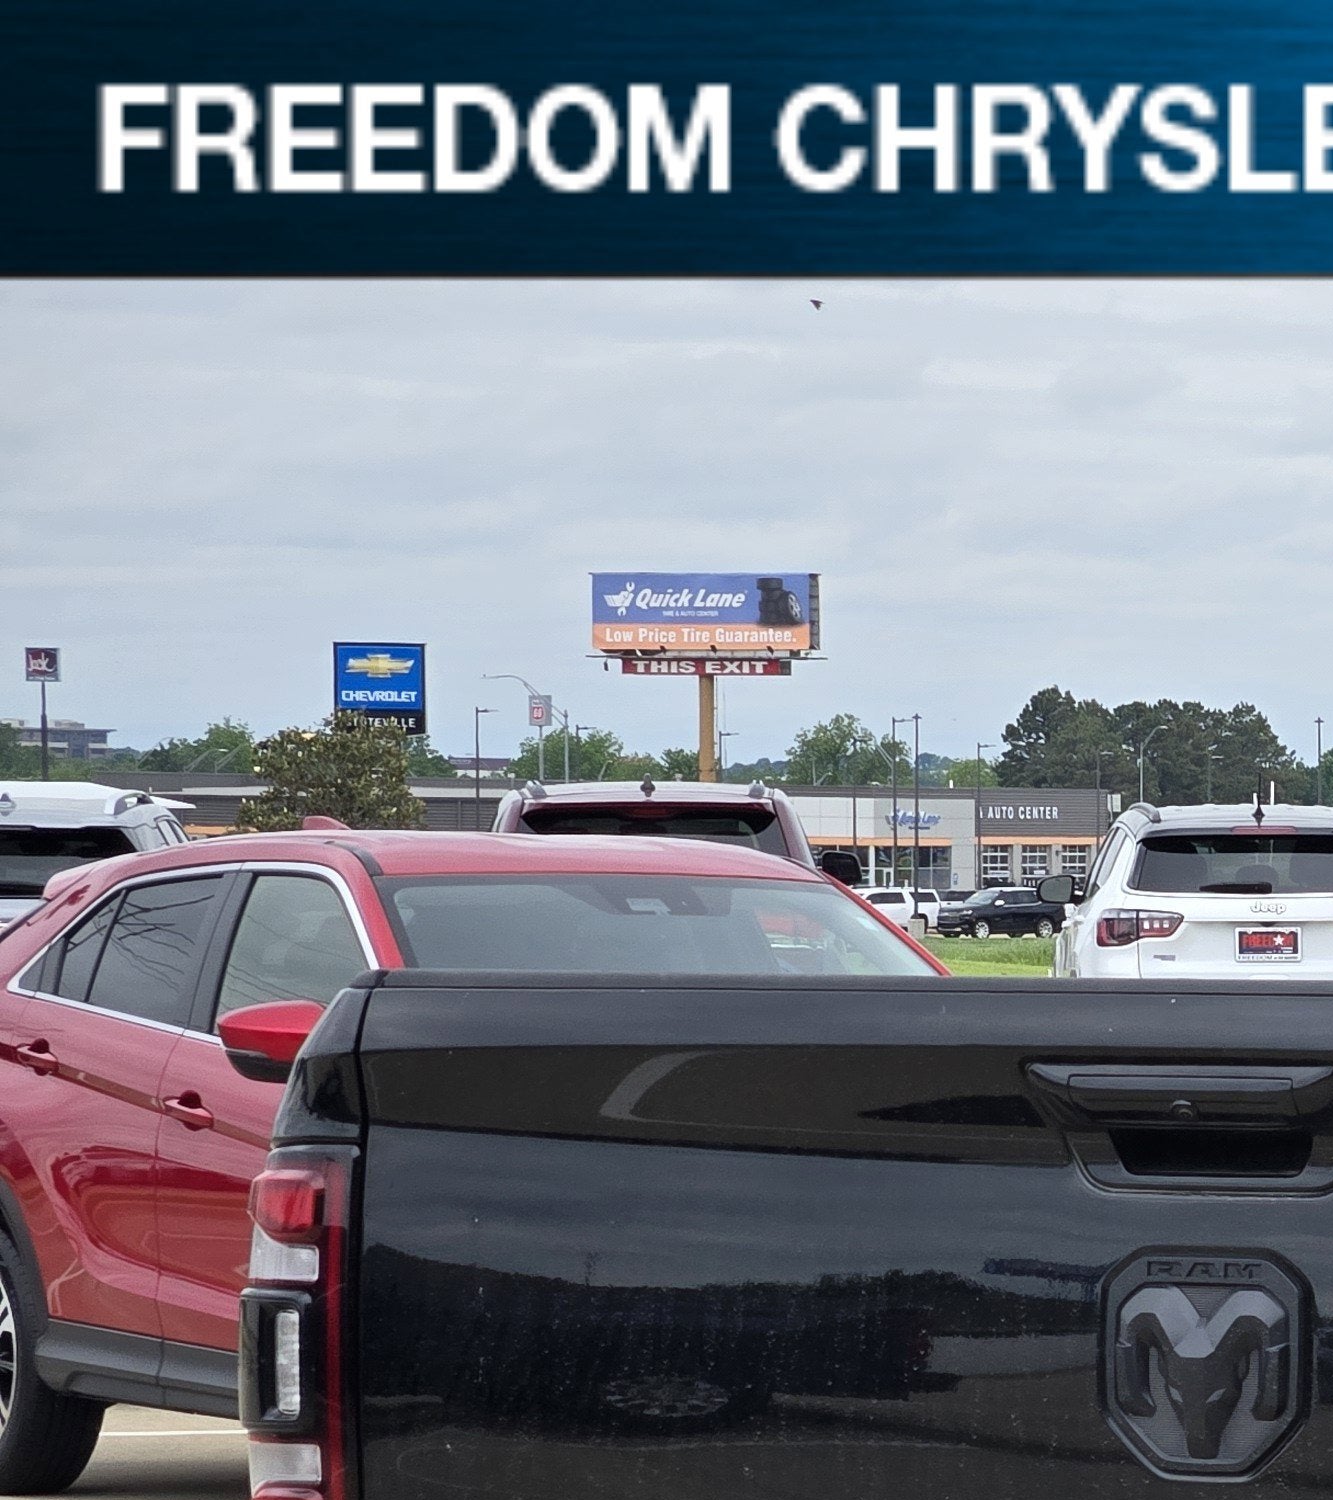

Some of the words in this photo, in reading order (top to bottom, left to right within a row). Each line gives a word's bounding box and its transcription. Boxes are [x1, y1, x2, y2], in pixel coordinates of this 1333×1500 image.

[636, 588, 691, 609] Quick
[694, 588, 746, 608] Lane
[605, 628, 632, 643] Low
[639, 627, 676, 643] Price
[682, 628, 710, 643] Tire
[715, 628, 797, 644] Guarantee.
[632, 661, 697, 674] THIS
[705, 661, 768, 674] EXIT
[341, 690, 417, 703] CHEVROLET
[987, 806, 1014, 820] AUTO
[1018, 806, 1059, 820] CENTER
[1250, 901, 1287, 915] Jeep
[1146, 1261, 1262, 1279] RAM
